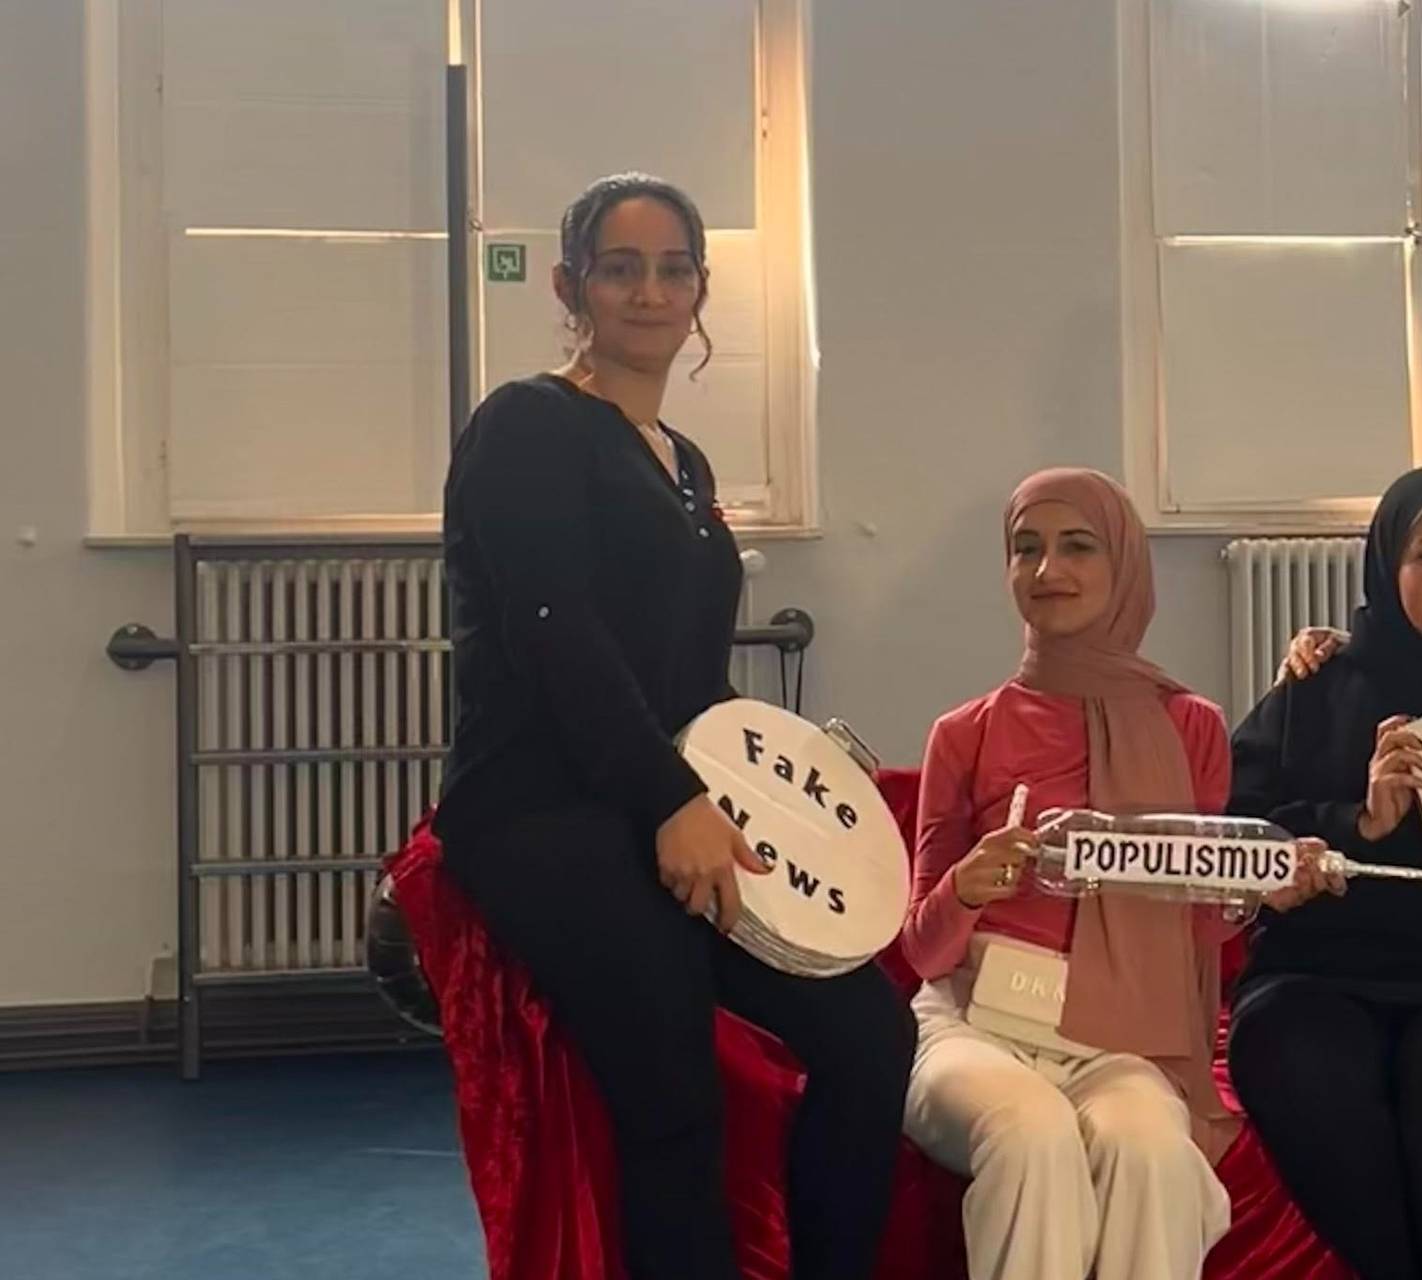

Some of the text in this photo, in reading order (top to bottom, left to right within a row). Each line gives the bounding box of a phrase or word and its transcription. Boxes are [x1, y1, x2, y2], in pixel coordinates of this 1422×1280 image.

[743, 728, 858, 829] Fake
[718, 795, 847, 915] News
[1074, 838, 1290, 880] POPULISMUS
